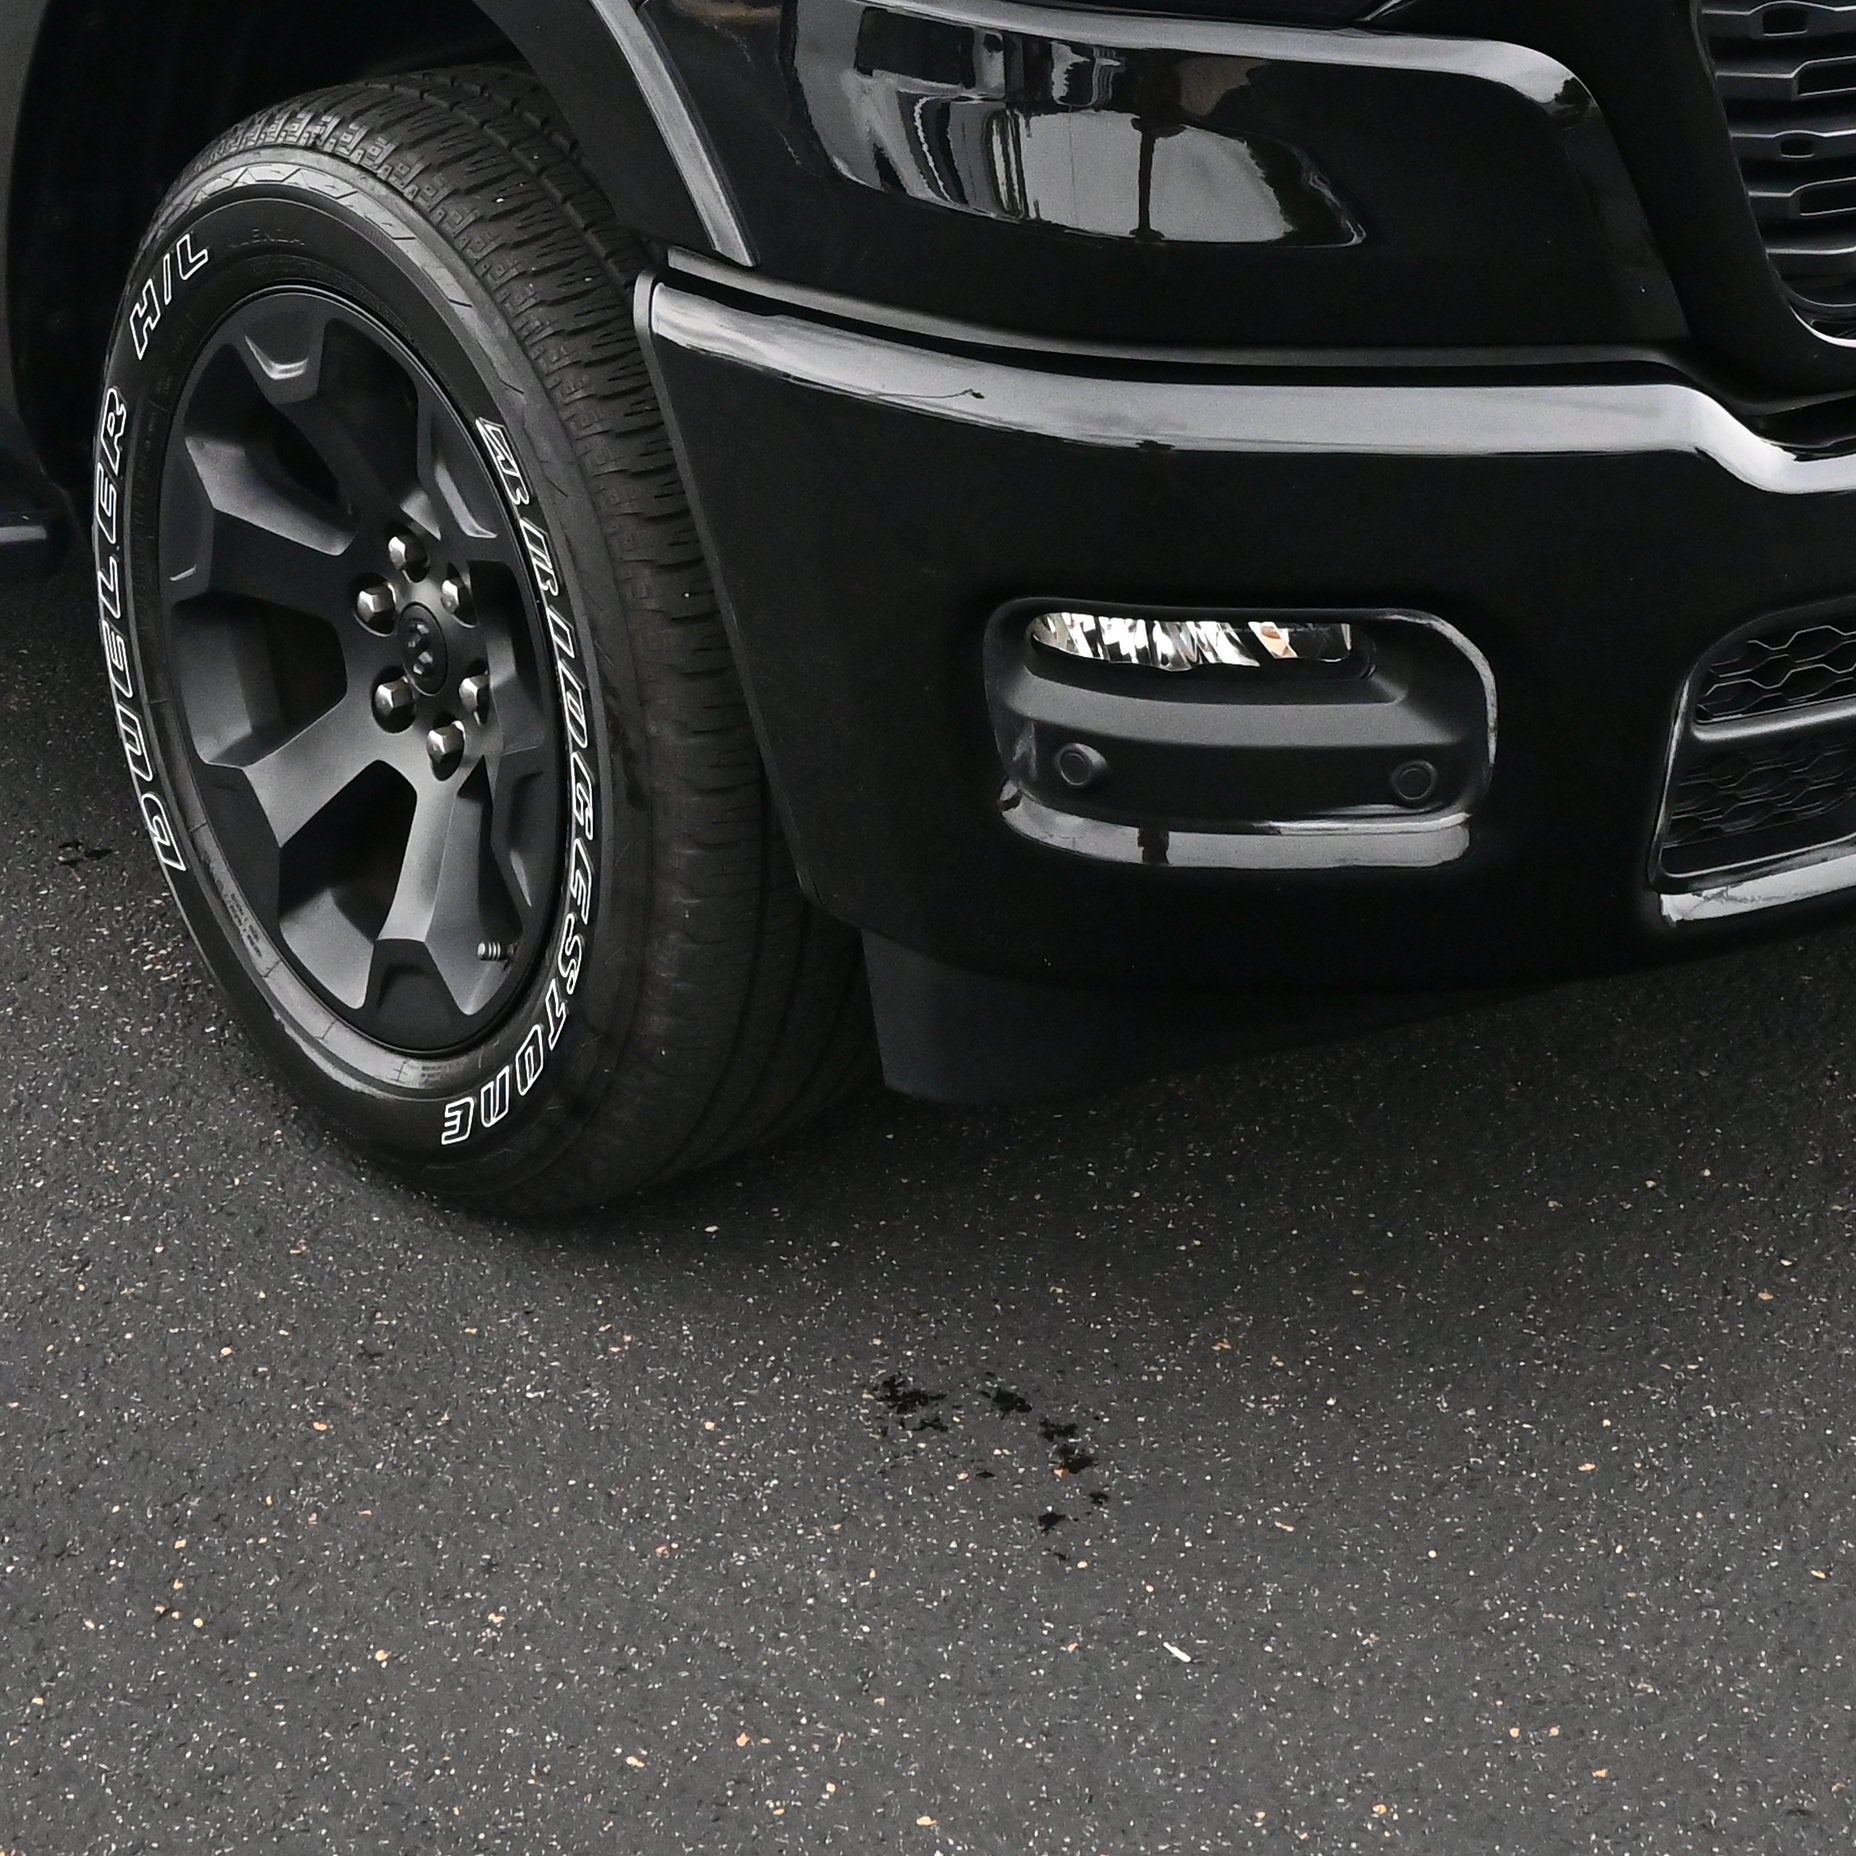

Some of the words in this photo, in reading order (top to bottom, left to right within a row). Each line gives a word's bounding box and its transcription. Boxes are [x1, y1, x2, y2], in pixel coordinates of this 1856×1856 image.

[129, 233, 209, 361] H/L
[96, 386, 186, 872] DUELER
[441, 415, 595, 1146] BRIDGESTONE
